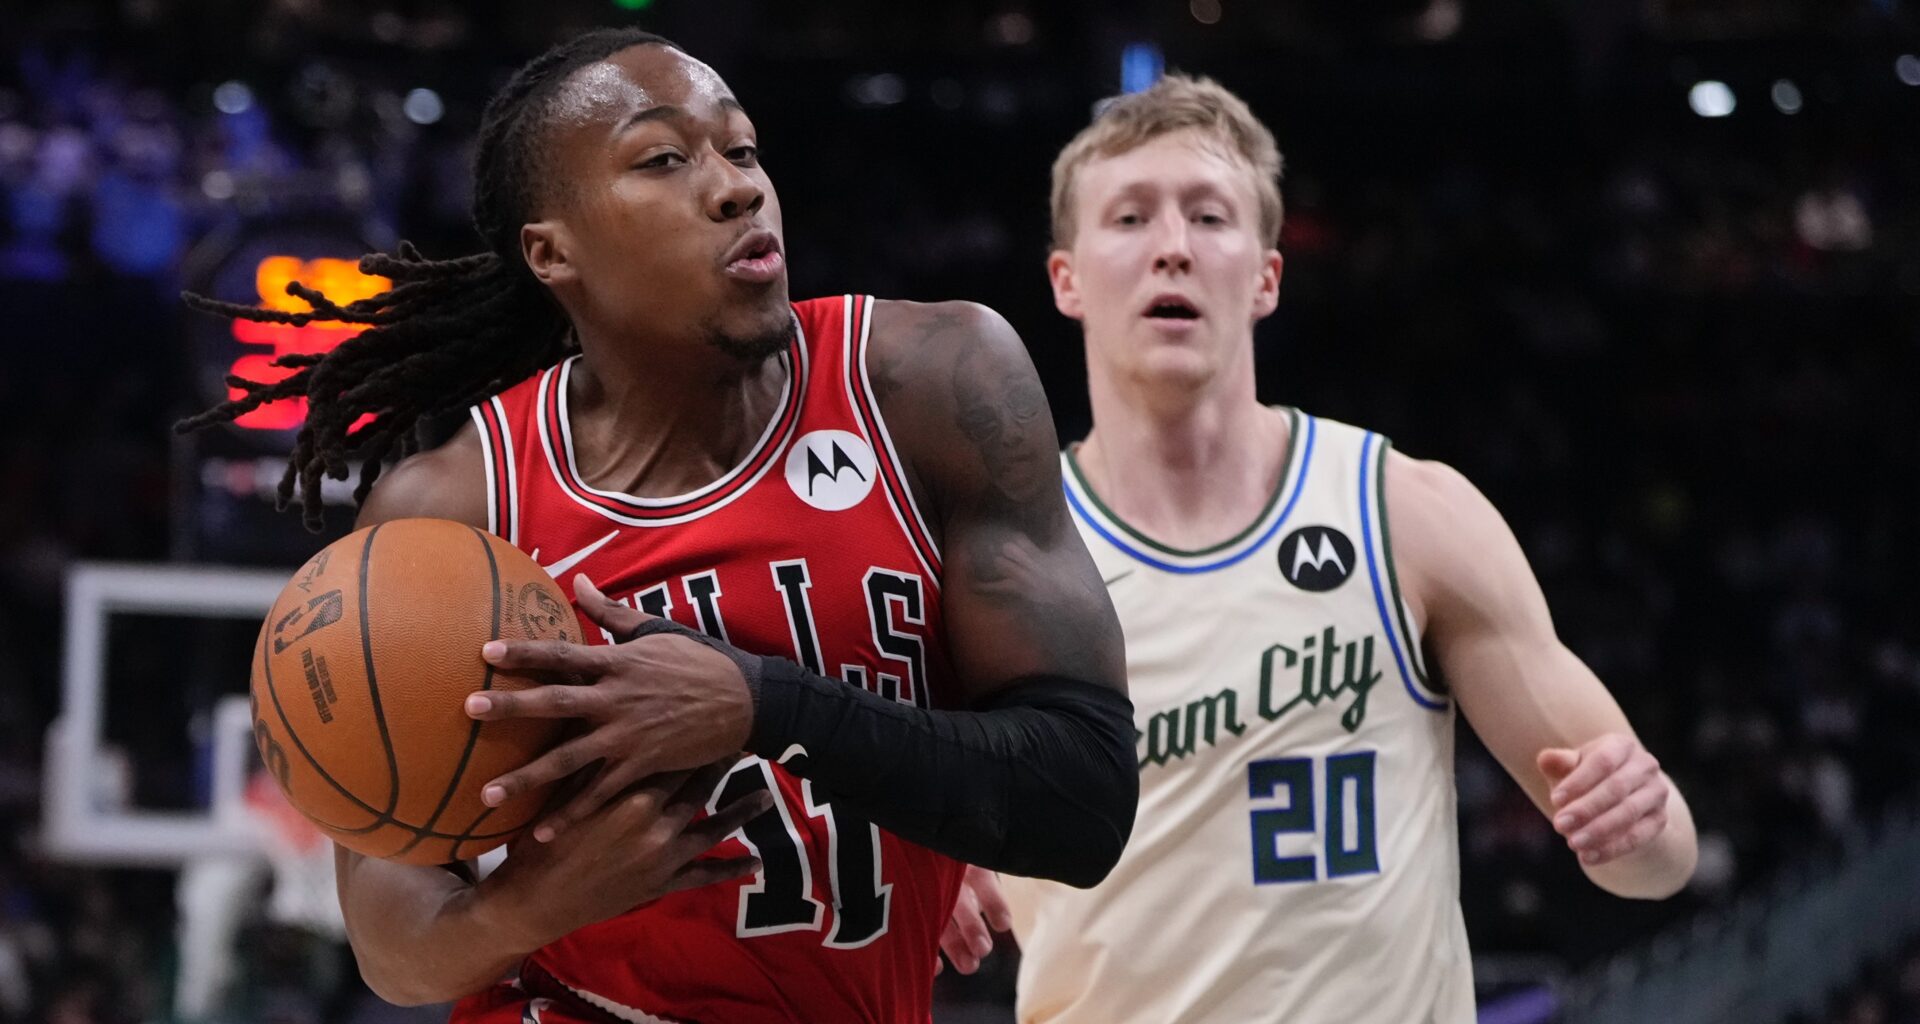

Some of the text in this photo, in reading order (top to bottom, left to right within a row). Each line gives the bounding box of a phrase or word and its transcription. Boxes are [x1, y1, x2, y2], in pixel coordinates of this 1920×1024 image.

[1258, 625, 1383, 734] City
[705, 754, 893, 950] 11
[1247, 750, 1381, 886] 20
